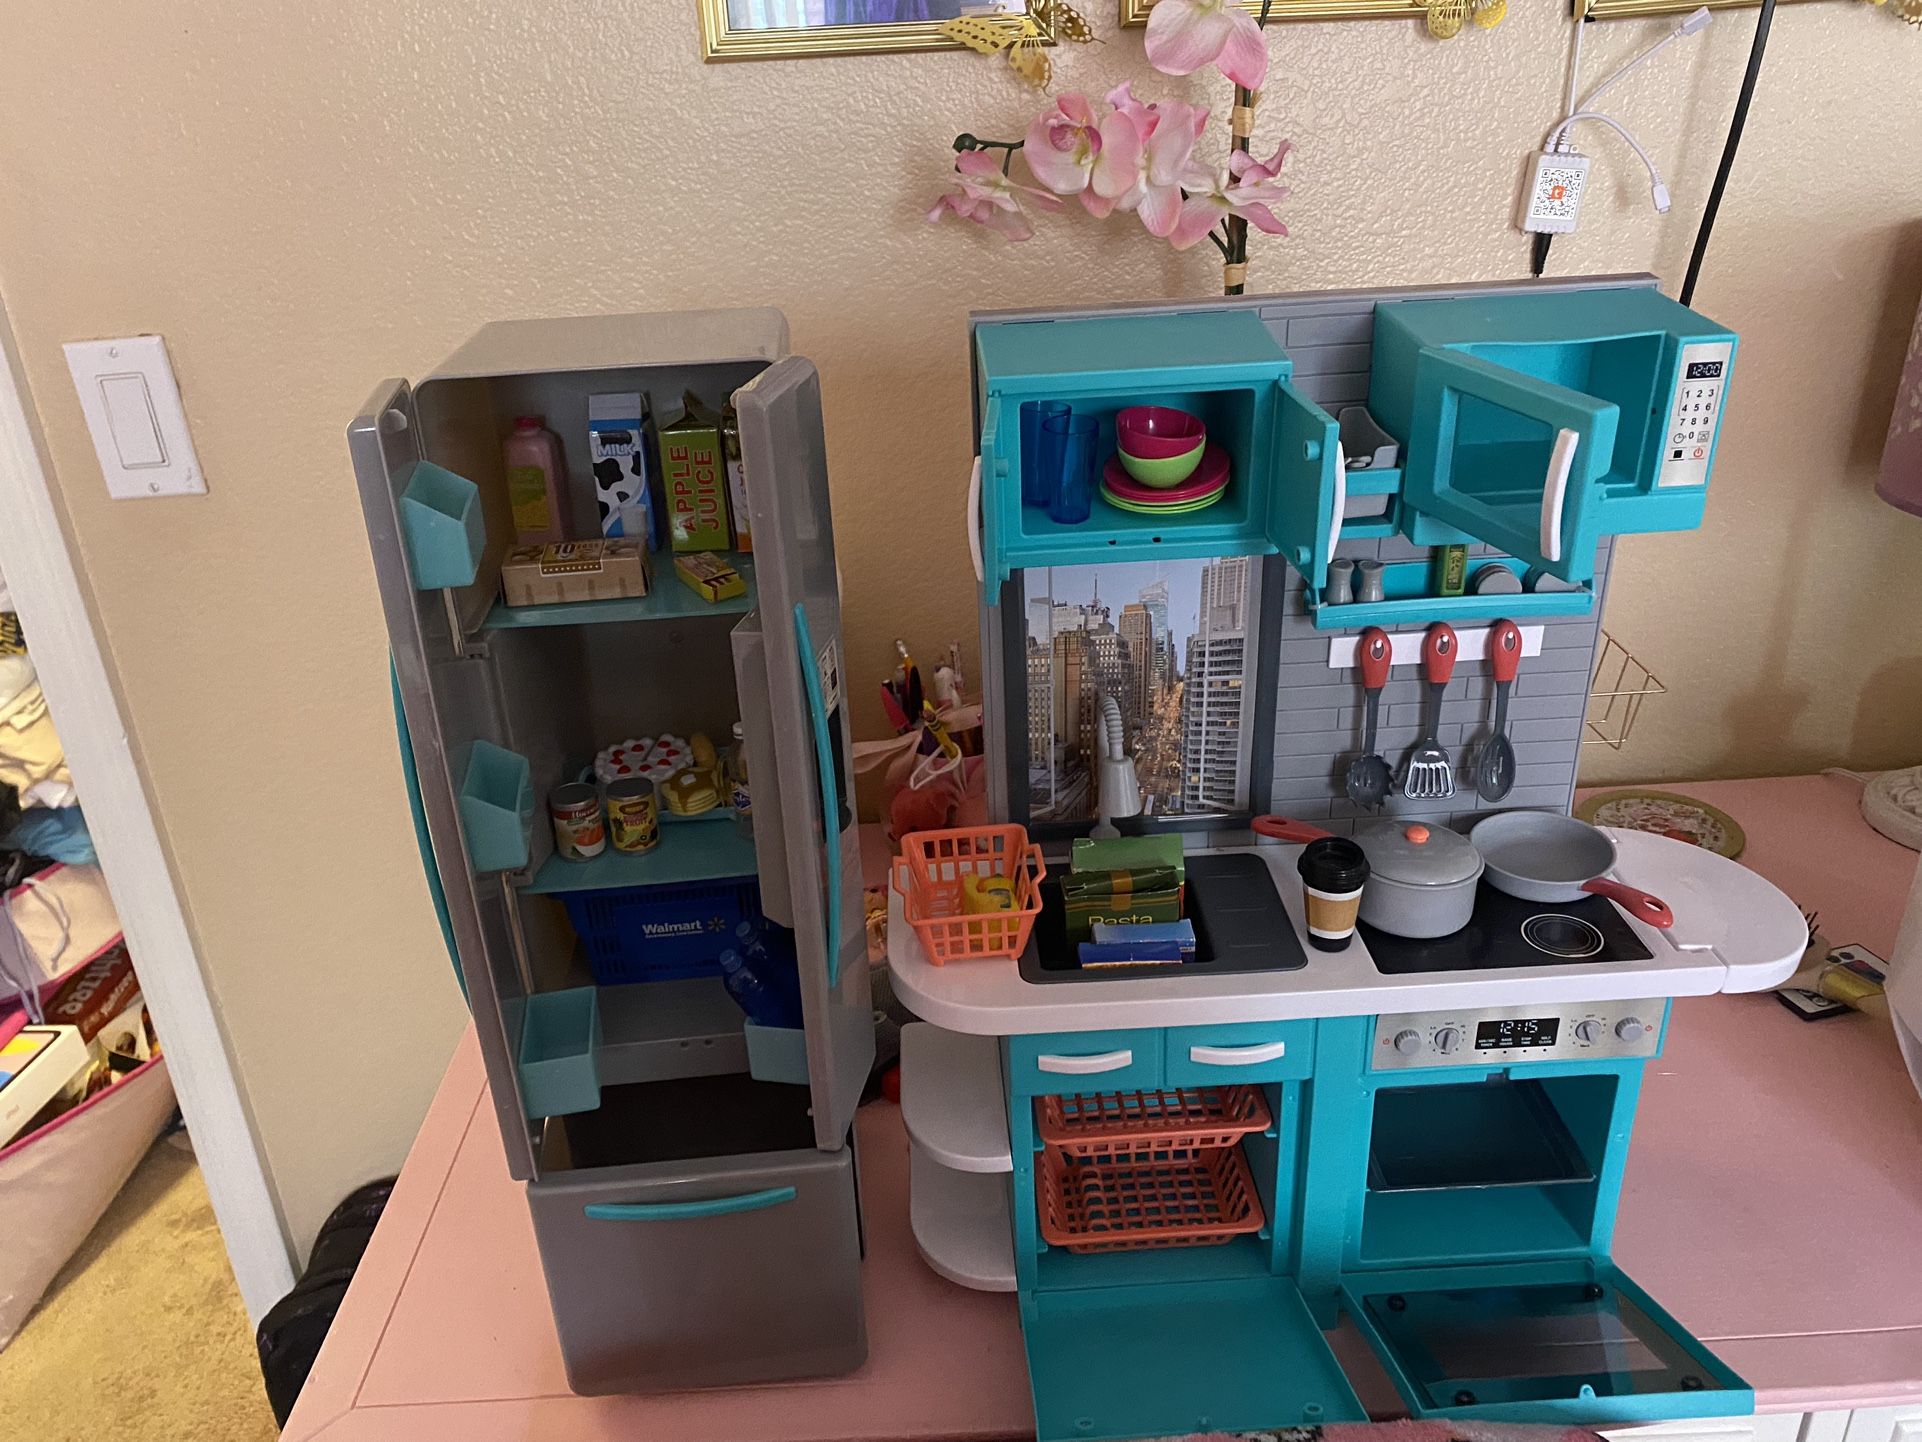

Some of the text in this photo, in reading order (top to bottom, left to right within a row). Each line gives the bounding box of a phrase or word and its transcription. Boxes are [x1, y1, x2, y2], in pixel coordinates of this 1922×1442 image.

[1693, 364, 1720, 376] 12:00
[1685, 390, 1690, 398] 1
[1708, 389, 1714, 397] 3
[1682, 403, 1711, 412] 4 5 6
[1680, 418, 1685, 426] 7
[597, 442, 636, 457] MILK
[670, 445, 697, 533] APPLE
[695, 449, 719, 530] JUICE
[642, 921, 703, 934] Walmart
[1500, 1020, 1537, 1034] 12:15
